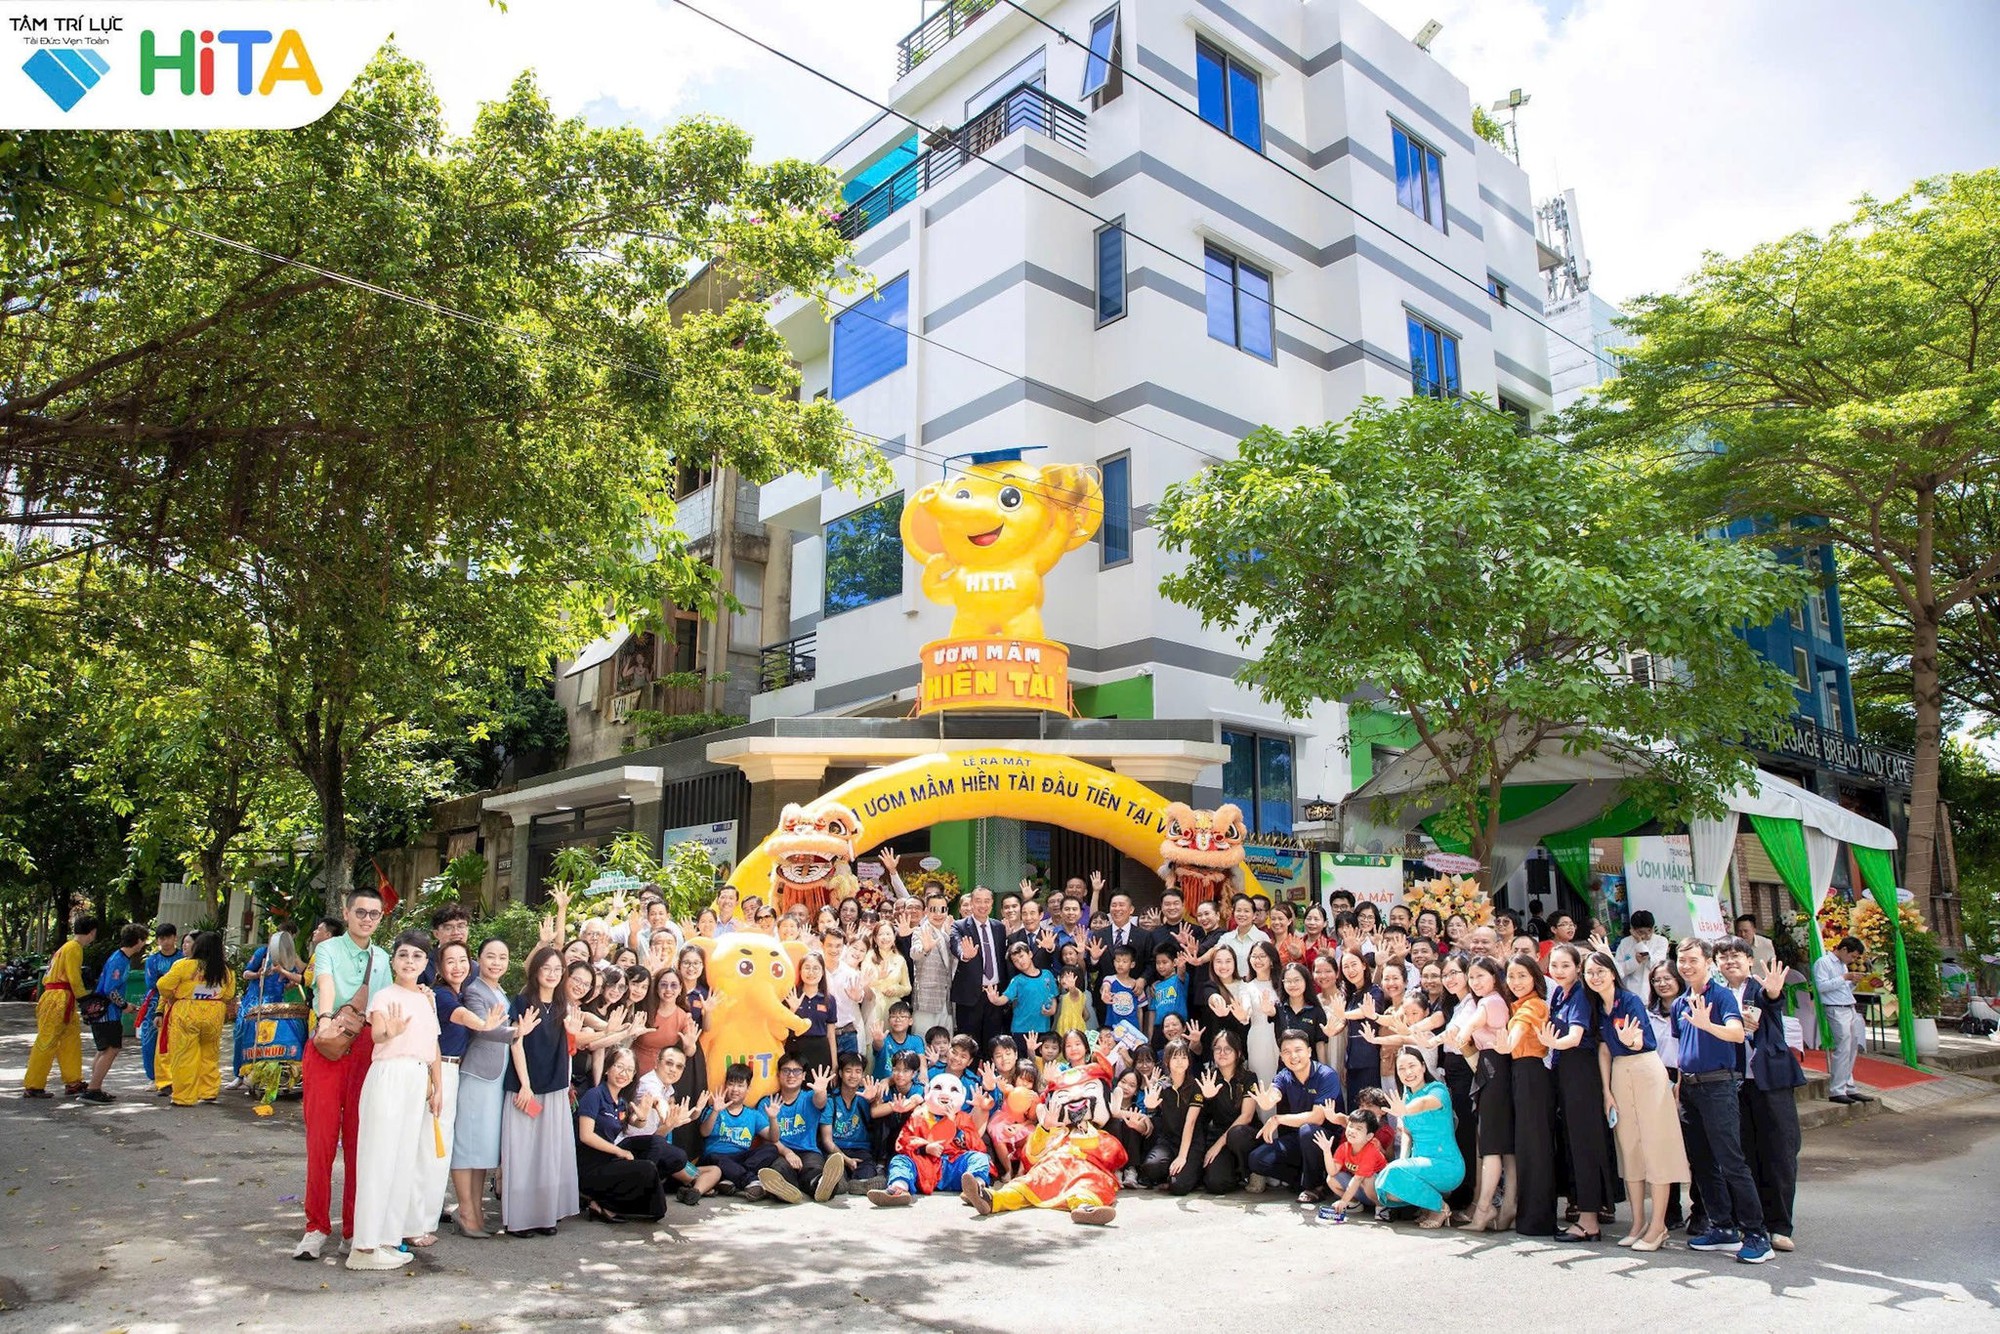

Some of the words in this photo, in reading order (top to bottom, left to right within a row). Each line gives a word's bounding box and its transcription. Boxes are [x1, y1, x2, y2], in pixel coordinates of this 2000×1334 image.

[965, 574, 1017, 593] HITA
[933, 645, 978, 665] ƯƠM
[925, 662, 997, 702] HIỀN
[1007, 665, 1057, 699] TÀI
[980, 757, 998, 765] RA
[1822, 737, 1859, 769] BREAD
[1862, 749, 1884, 776] AND
[1885, 756, 1911, 782] CAFE
[864, 790, 907, 817] ƯƠM
[910, 773, 955, 803] MẦM
[961, 766, 1000, 793] HIỀN
[1008, 771, 1035, 792] TÀI
[1041, 770, 1079, 798] ĐẦU
[1085, 787, 1121, 811] TIÊN
[1125, 800, 1153, 826] TẠI
[1636, 859, 1660, 879] ƯƠM
